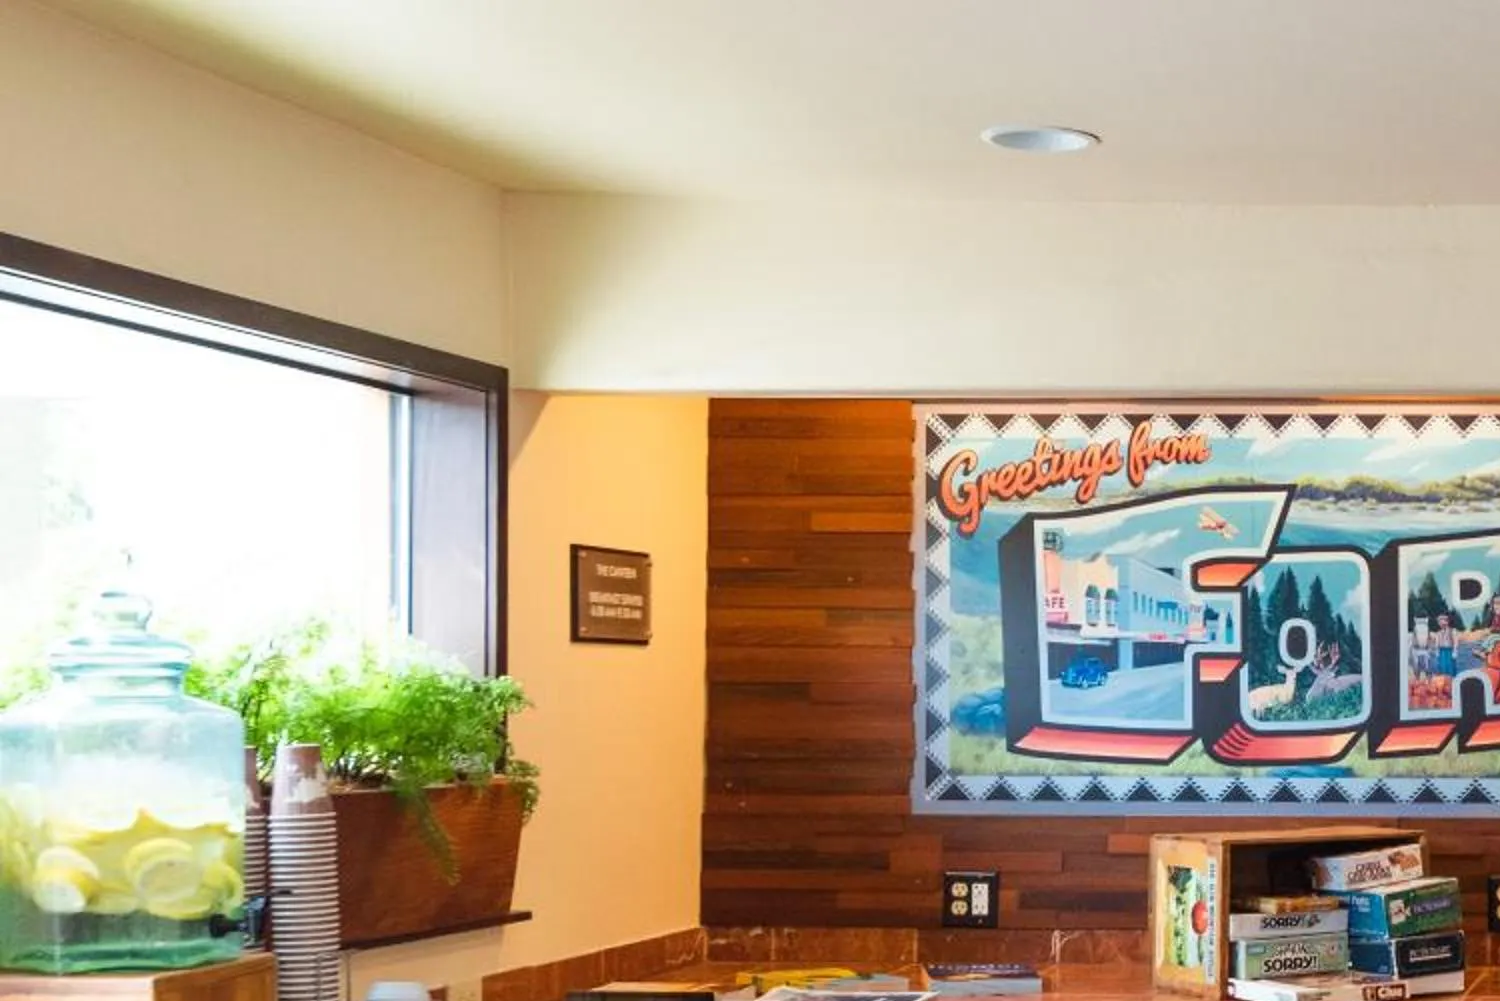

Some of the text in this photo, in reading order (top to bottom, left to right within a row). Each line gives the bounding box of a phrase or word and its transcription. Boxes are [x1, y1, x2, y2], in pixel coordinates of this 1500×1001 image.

[939, 420, 1211, 539] Greetings from
[1263, 956, 1317, 973] SORRY!
